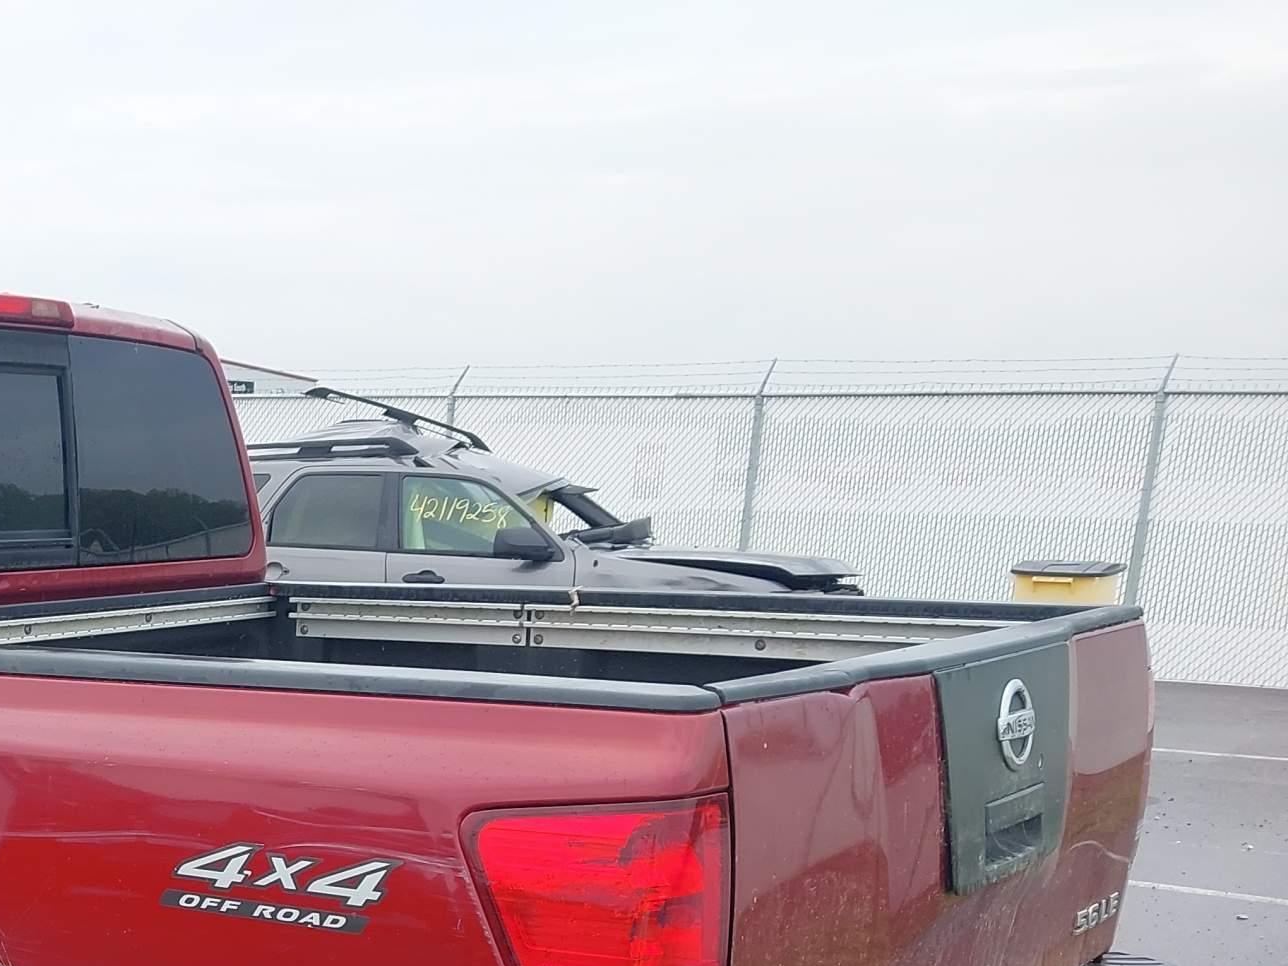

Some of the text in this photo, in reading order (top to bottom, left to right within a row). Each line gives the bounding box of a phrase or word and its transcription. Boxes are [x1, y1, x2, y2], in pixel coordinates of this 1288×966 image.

[409, 493, 510, 529] 42119258
[178, 893, 348, 930] OFF ROAD
